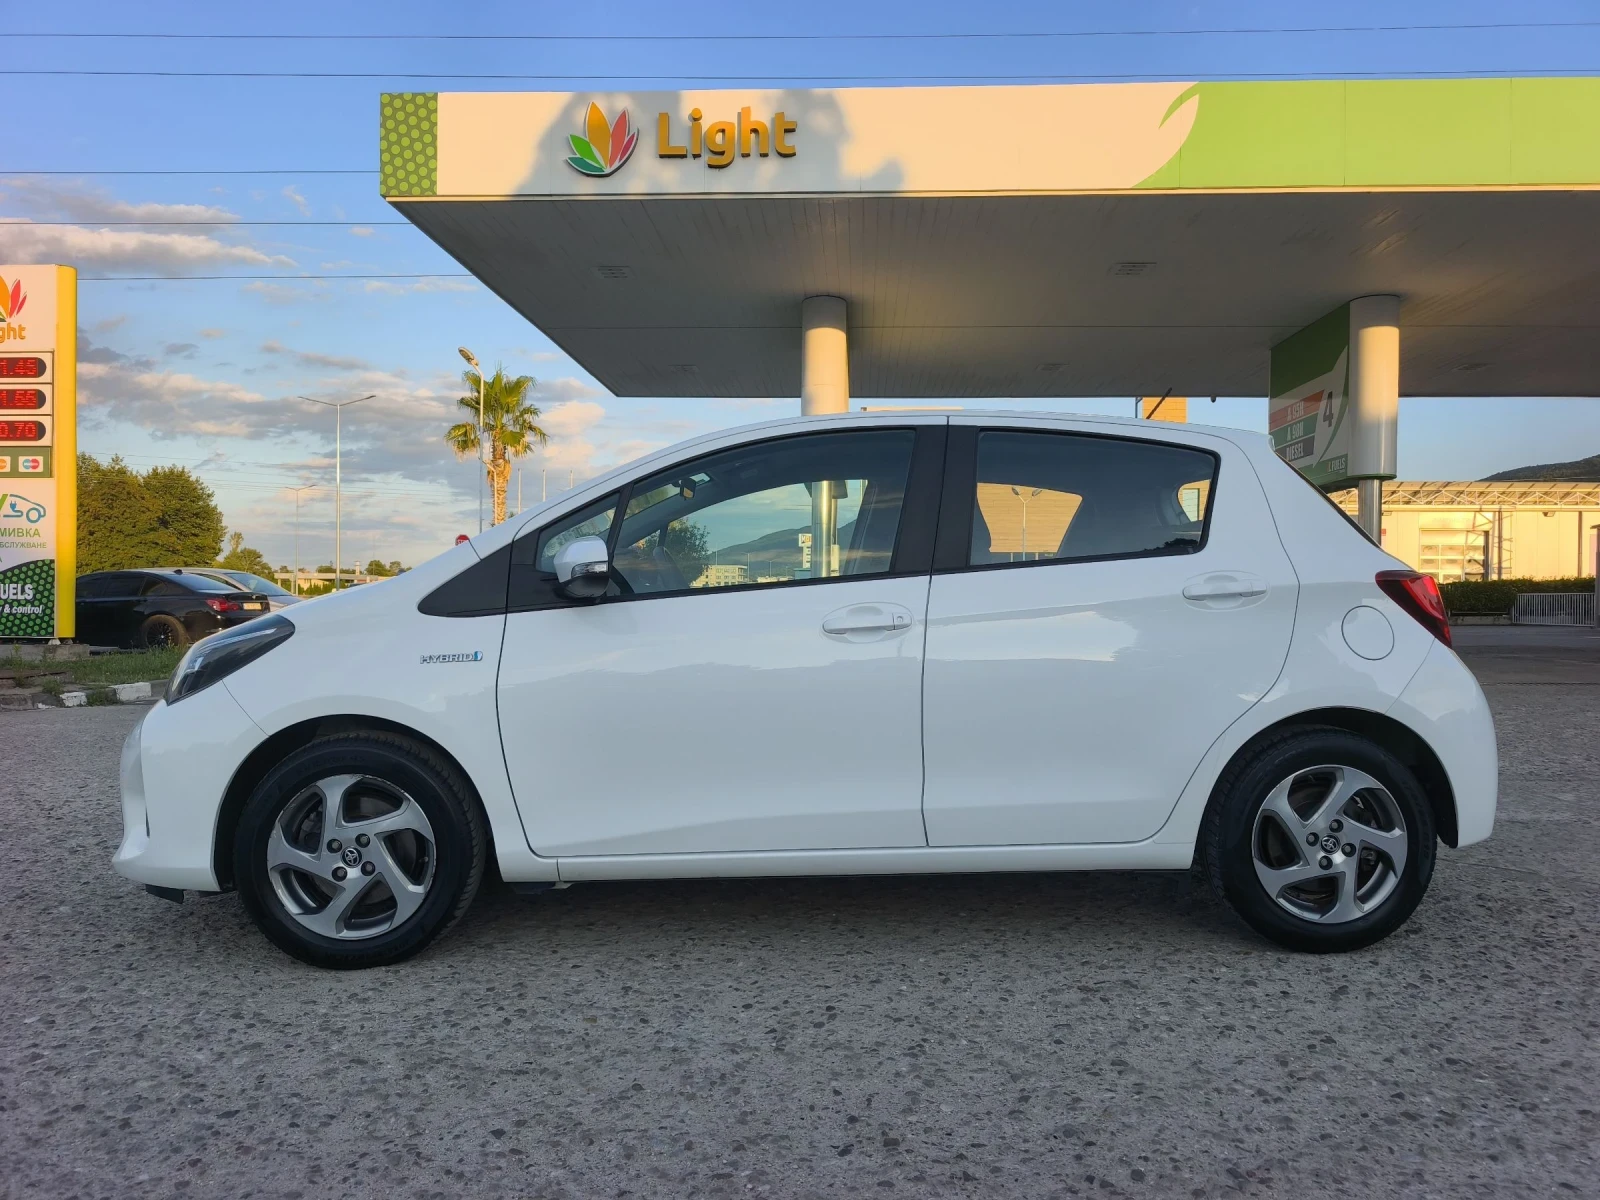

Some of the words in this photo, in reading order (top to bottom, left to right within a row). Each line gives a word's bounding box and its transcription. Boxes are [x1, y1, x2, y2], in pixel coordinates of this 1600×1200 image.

[658, 106, 797, 168] Light
[1323, 391, 1333, 428] 4
[1286, 443, 1304, 462] DIESEL
[3, 603, 11, 614] &
[12, 605, 43, 614] control
[420, 653, 474, 664] HYBRID
